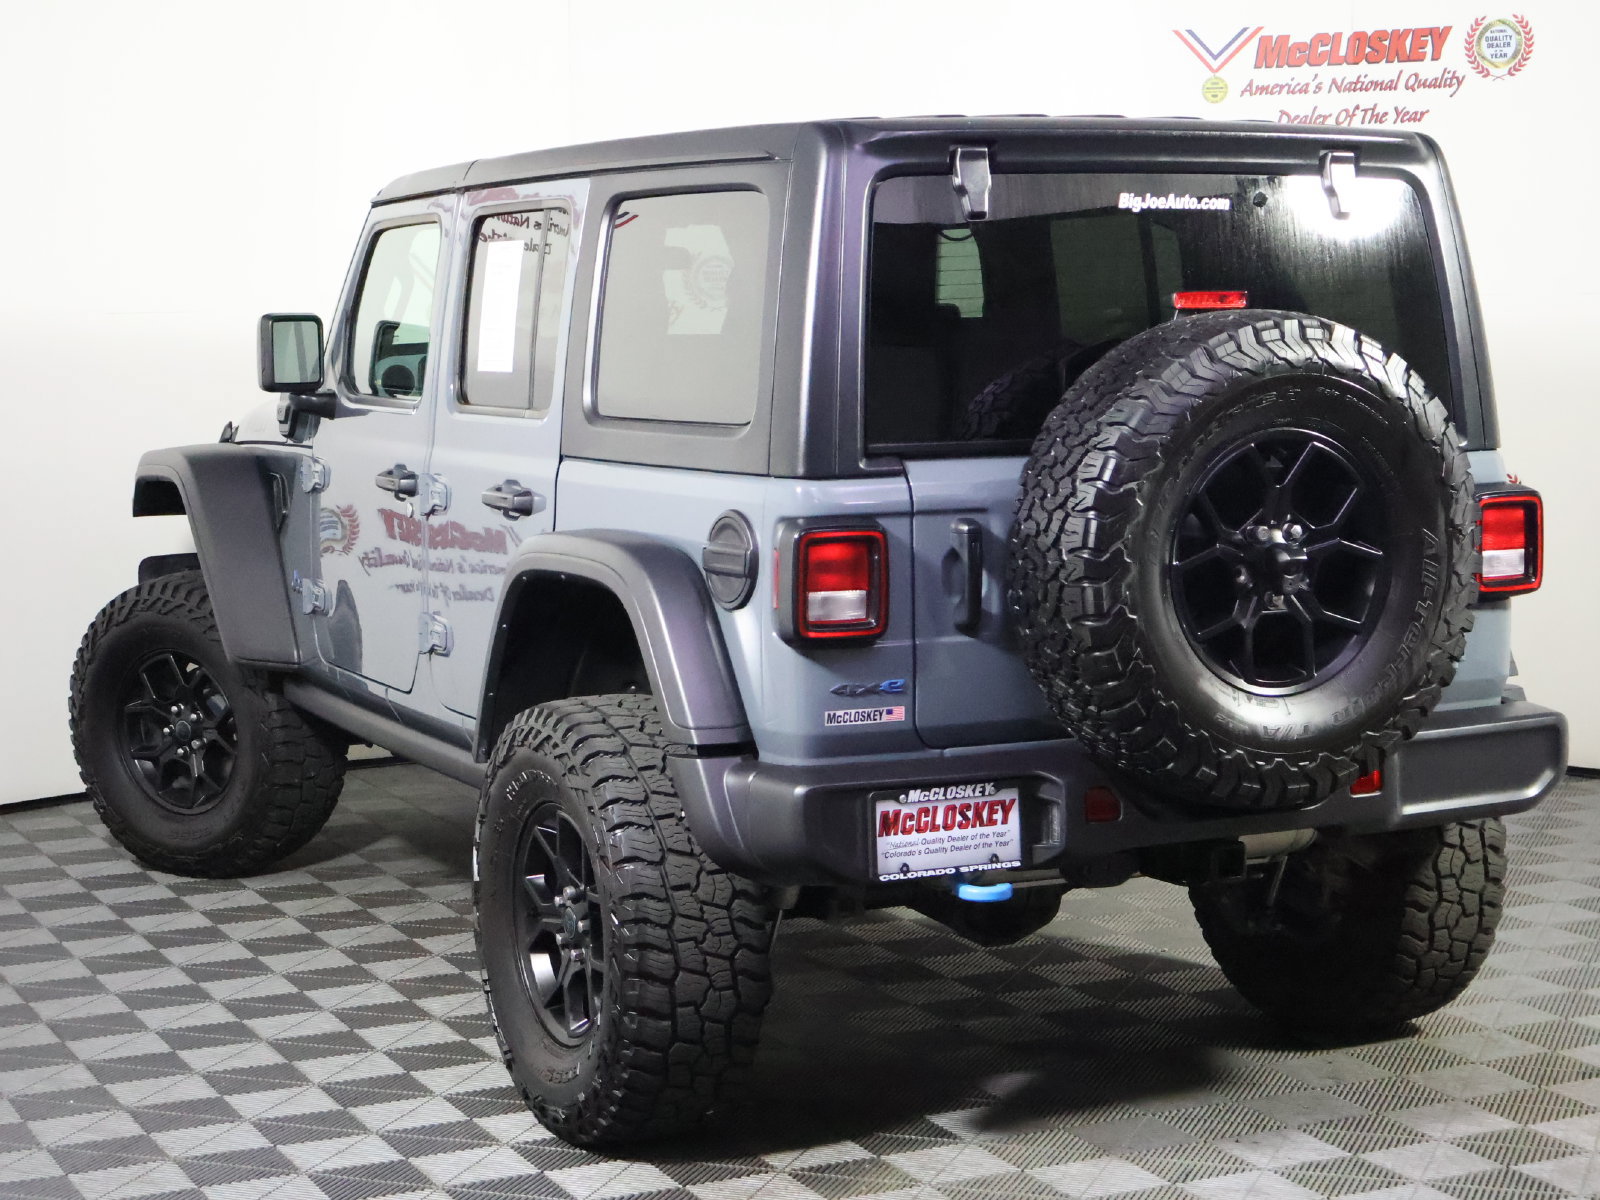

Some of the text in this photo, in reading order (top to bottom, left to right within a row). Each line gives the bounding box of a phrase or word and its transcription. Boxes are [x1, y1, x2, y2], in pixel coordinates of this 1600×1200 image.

[1254, 26, 1453, 69] McCLOSKEY
[1240, 74, 1323, 97] America's
[1328, 70, 1403, 94] National
[1404, 68, 1466, 98] Quality
[1278, 103, 1430, 126] Dealer Of The Year
[1118, 192, 1230, 212] BigJoeAuto.com
[826, 709, 885, 725] McCLOSKEY
[907, 782, 994, 803] McCLOSKEY
[878, 798, 1017, 837] McCLOSKEY
[920, 836, 946, 846] Quality
[947, 834, 970, 843] Dealer
[970, 832, 979, 841] of
[979, 832, 991, 840] the
[923, 846, 948, 855] Quality
[950, 843, 972, 852] Dealer
[973, 842, 981, 850] of
[981, 841, 993, 849] the
[879, 860, 1021, 882] COLORADO SPRINGS
